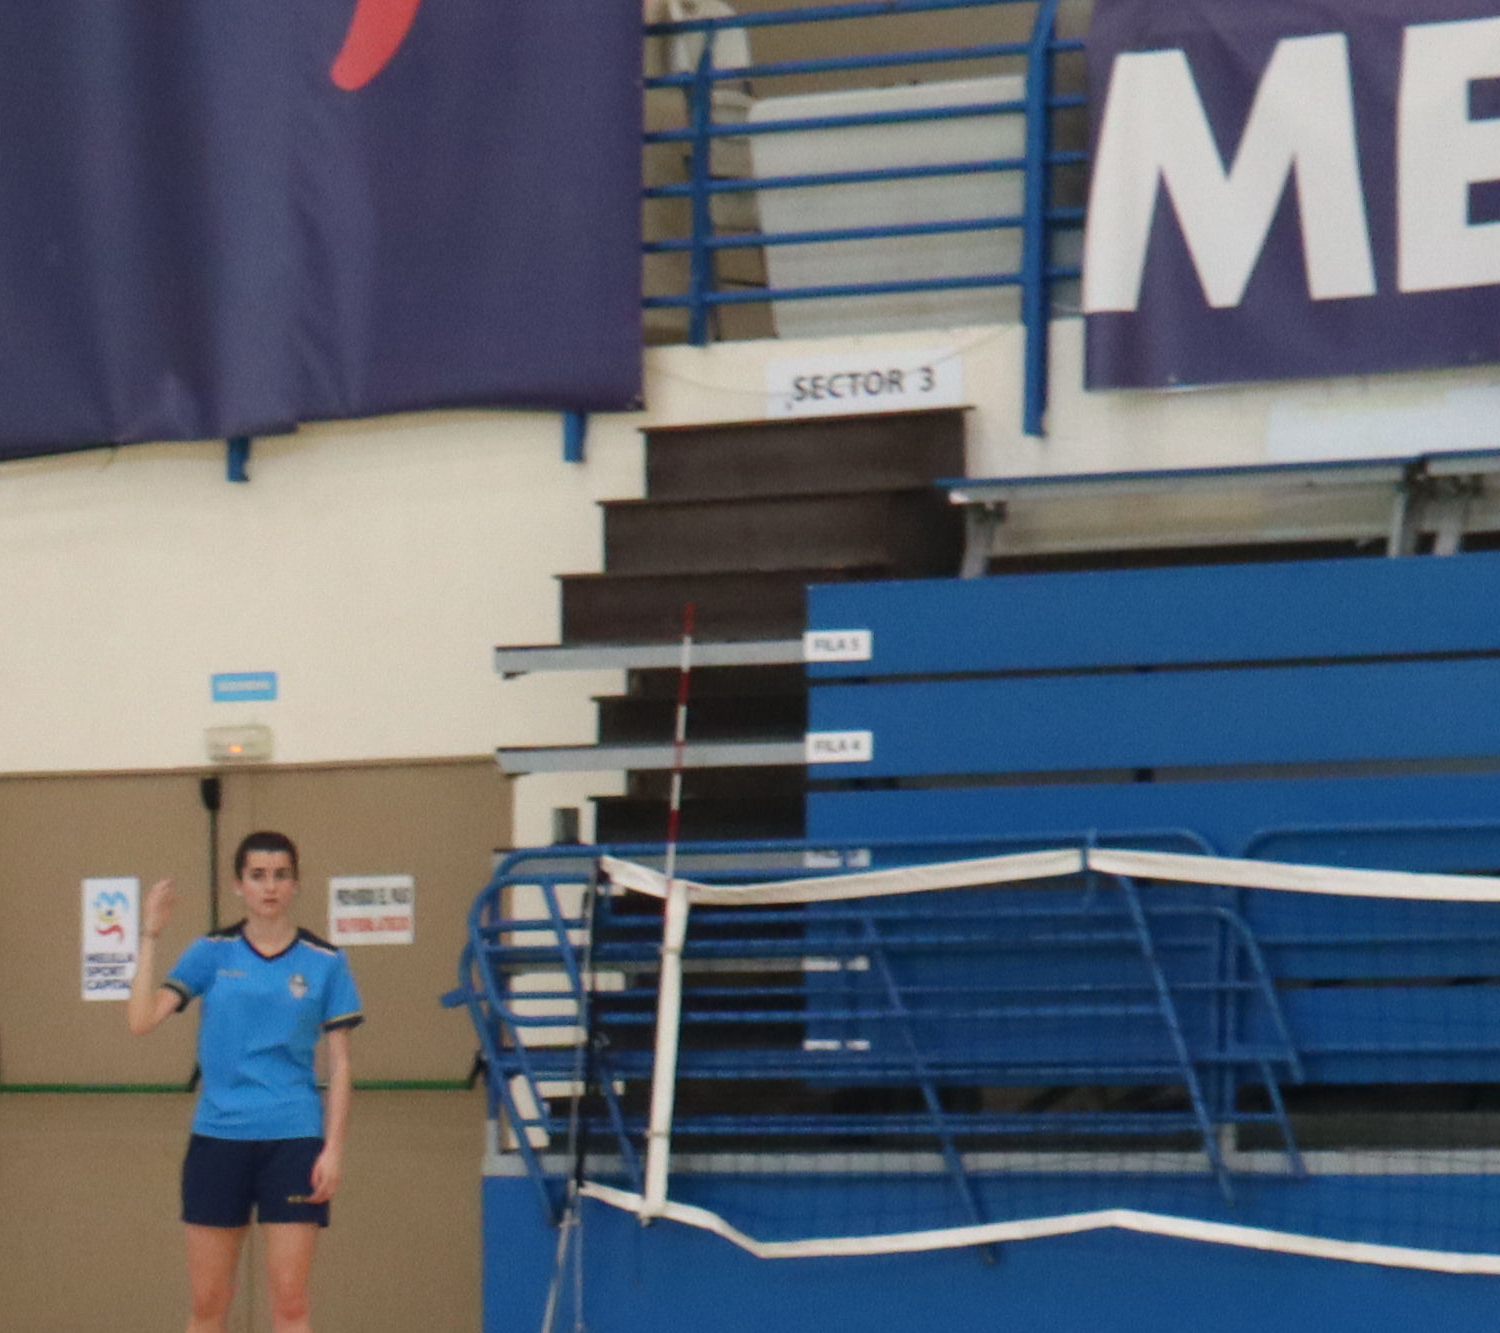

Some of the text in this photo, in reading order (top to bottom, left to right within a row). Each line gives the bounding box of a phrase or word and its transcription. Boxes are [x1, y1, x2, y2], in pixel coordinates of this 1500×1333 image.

[1082, 15, 1500, 314] ME
[792, 365, 935, 402] SECTOR 3
[814, 638, 845, 652] FILA
[814, 739, 847, 753] FILA
